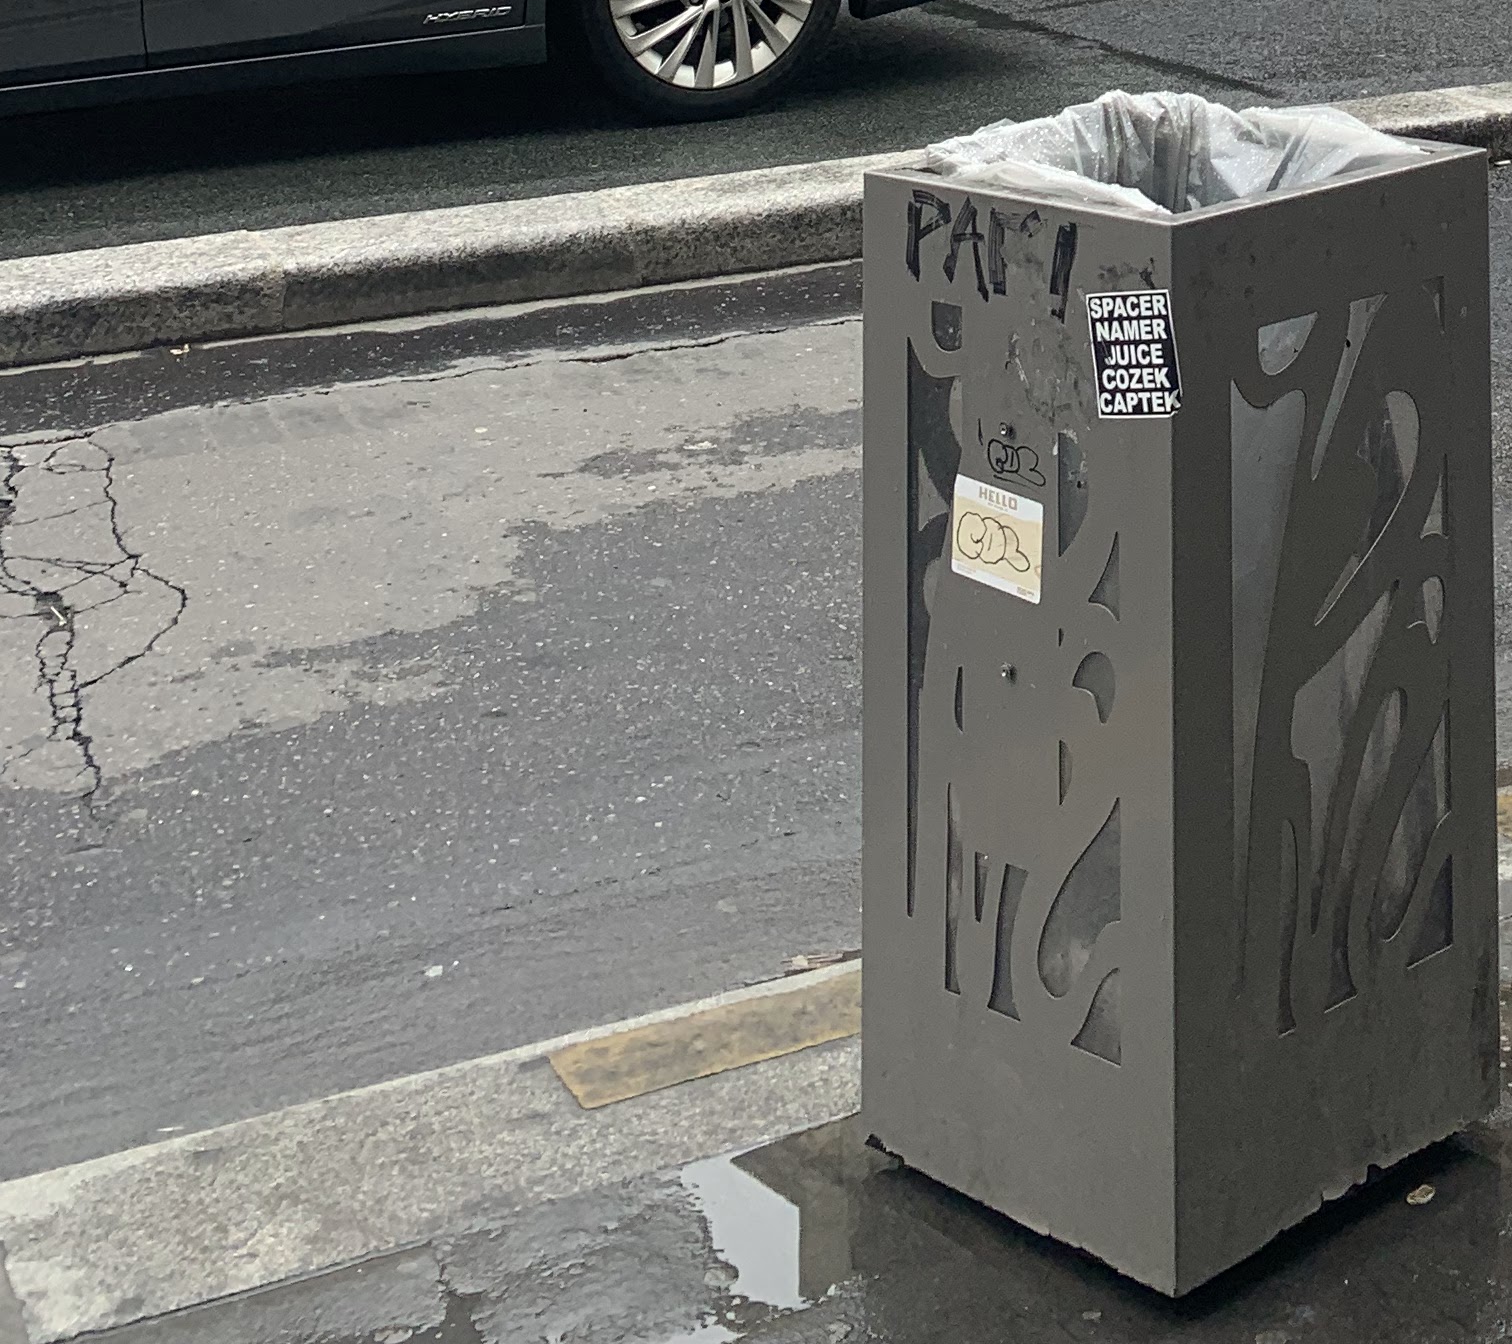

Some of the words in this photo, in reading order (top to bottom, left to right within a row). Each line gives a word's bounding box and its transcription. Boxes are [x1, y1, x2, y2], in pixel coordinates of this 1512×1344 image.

[422, 6, 512, 25] HYBRID
[1089, 294, 1168, 319] SPACER
[1095, 318, 1168, 342] NAMER
[1104, 343, 1165, 366] JUICE
[1101, 367, 1172, 390] COZEK
[1100, 388, 1181, 413] CAPTEK
[978, 485, 1018, 511] HELLO
